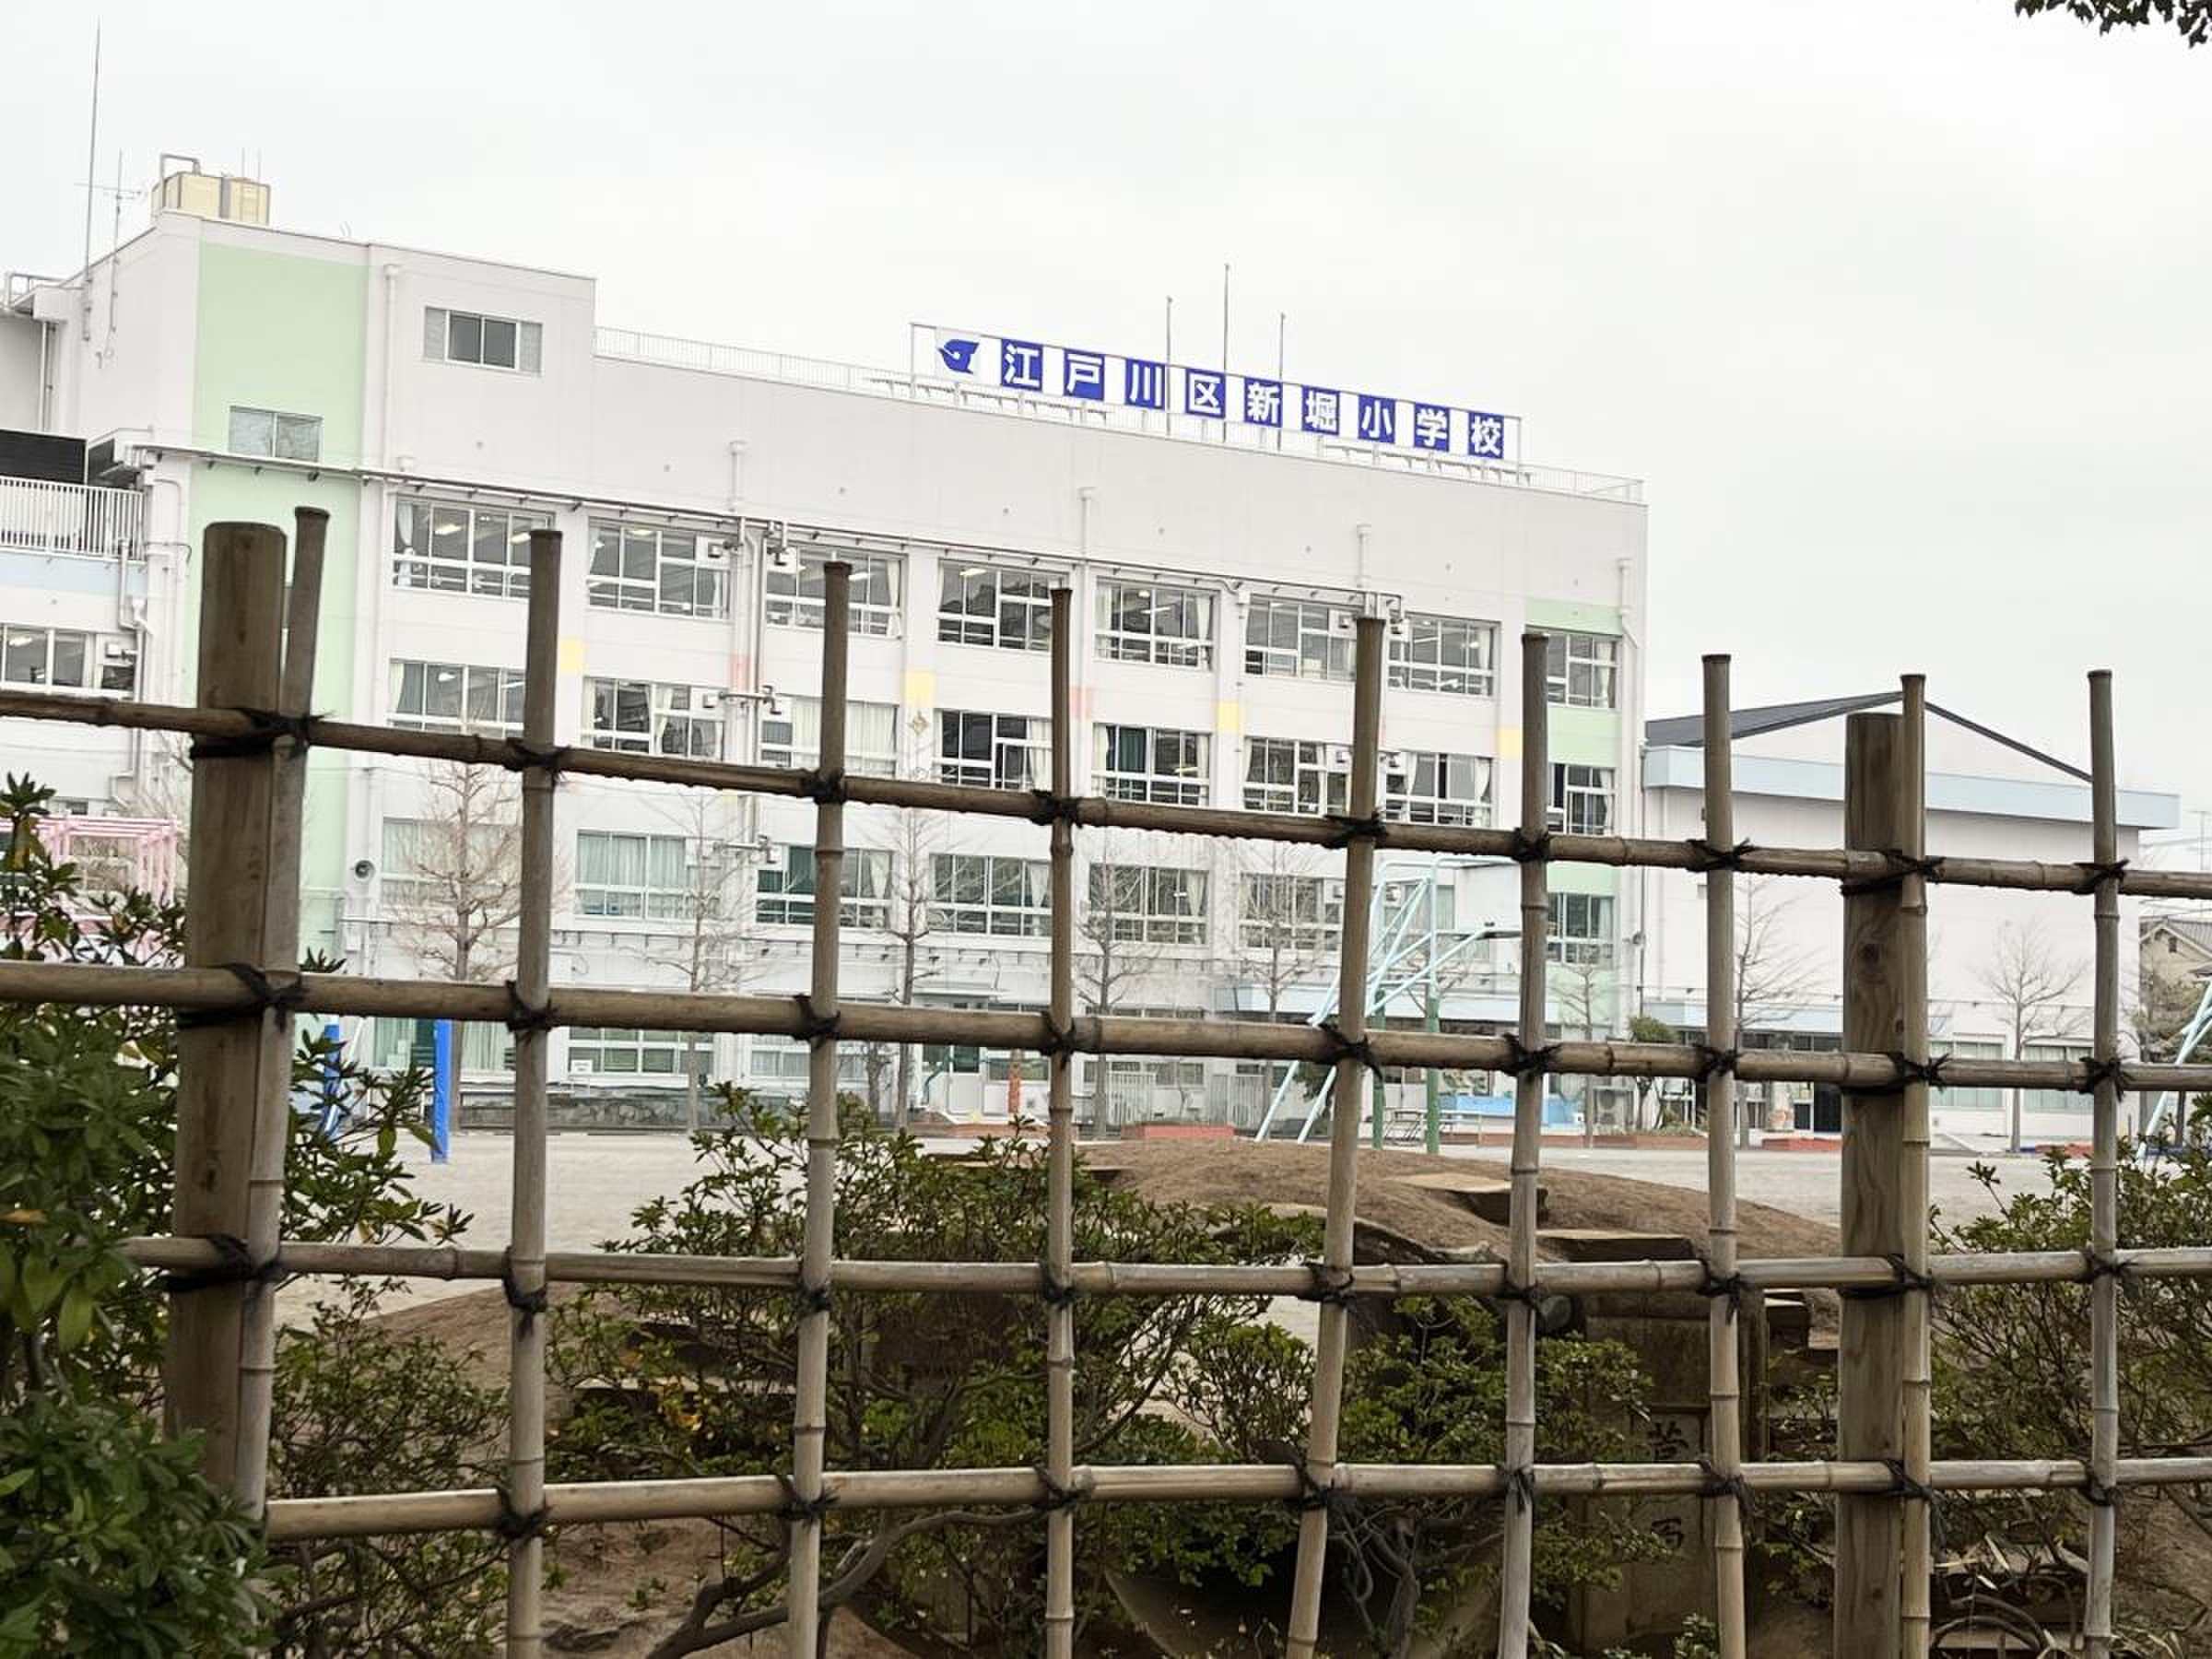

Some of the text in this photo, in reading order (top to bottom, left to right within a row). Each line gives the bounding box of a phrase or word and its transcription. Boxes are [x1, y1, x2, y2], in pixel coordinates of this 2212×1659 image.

[1005, 343, 1501, 457] 江戸川区新堀小学校
